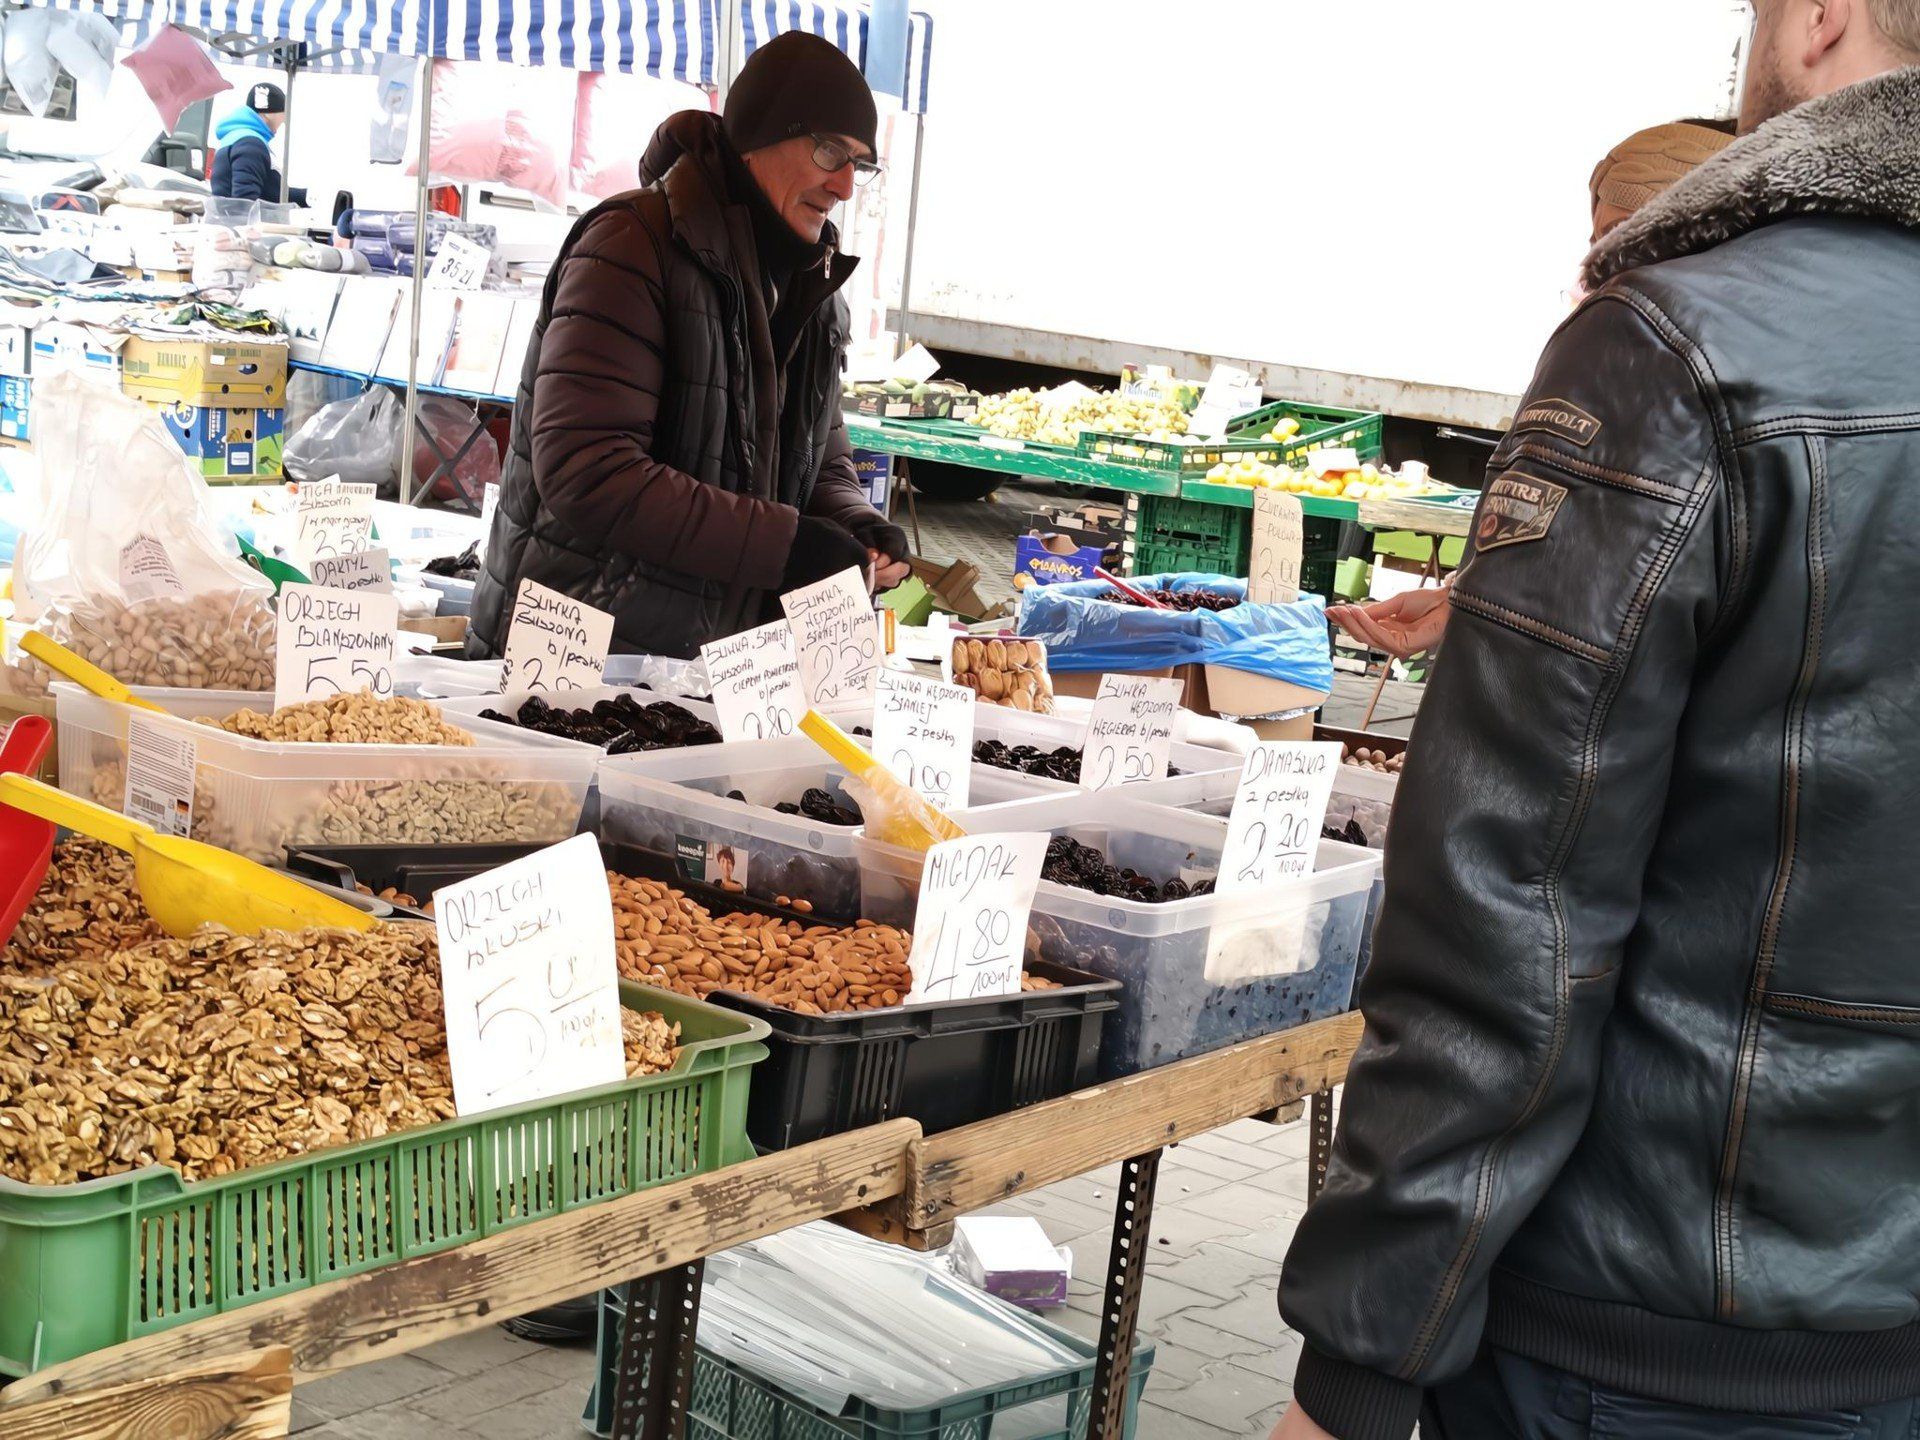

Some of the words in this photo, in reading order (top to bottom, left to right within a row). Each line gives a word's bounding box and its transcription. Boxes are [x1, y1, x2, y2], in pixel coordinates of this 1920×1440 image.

[315, 555, 369, 586] DAKTYL
[286, 591, 360, 622] ORZECH
[306, 656, 343, 693] 5
[814, 644, 839, 704] 2
[839, 637, 876, 676] 50
[1125, 746, 1155, 779] 50
[1237, 821, 1267, 883] 2
[1276, 812, 1310, 849] 20
[445, 872, 544, 943] ORZECH
[924, 911, 960, 1001] 4
[972, 908, 1011, 960] 80
[474, 976, 548, 1097] 5
